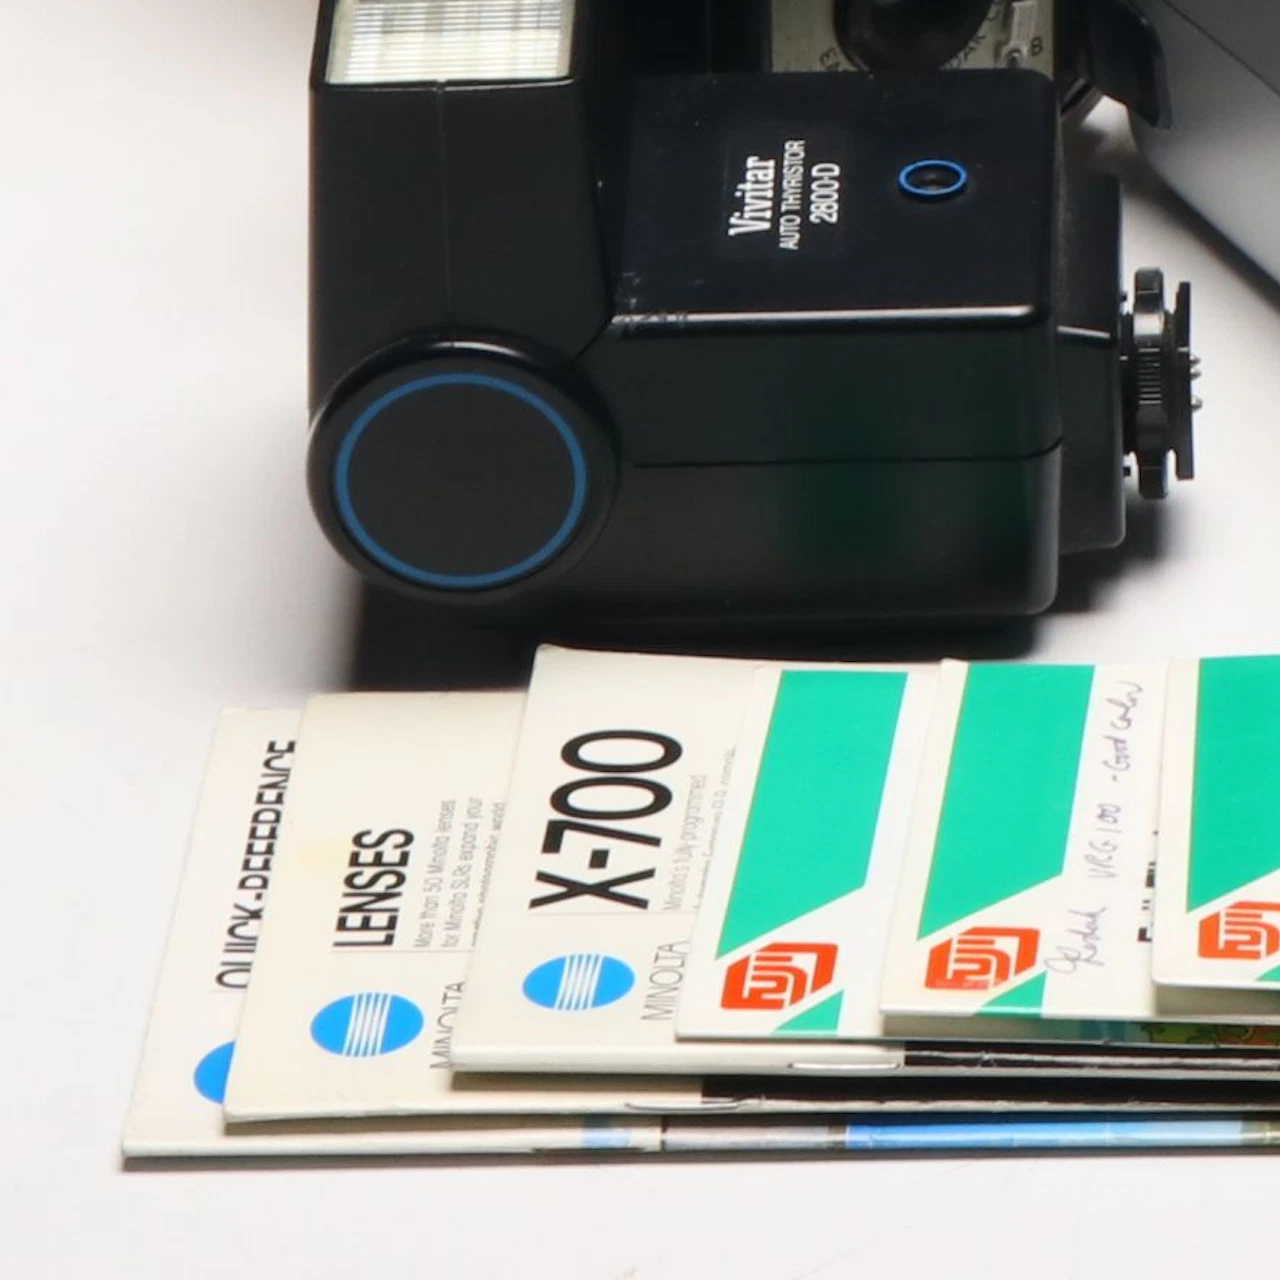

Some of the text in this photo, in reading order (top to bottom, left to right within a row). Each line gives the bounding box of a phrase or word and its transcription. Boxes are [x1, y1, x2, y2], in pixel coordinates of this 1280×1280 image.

[727, 155, 776, 237] Vivitar
[778, 139, 806, 251] AUTO THYRISTOR
[528, 728, 684, 911] X-700
[332, 828, 415, 948] LENSES
[640, 940, 691, 1022] MINOLTA
